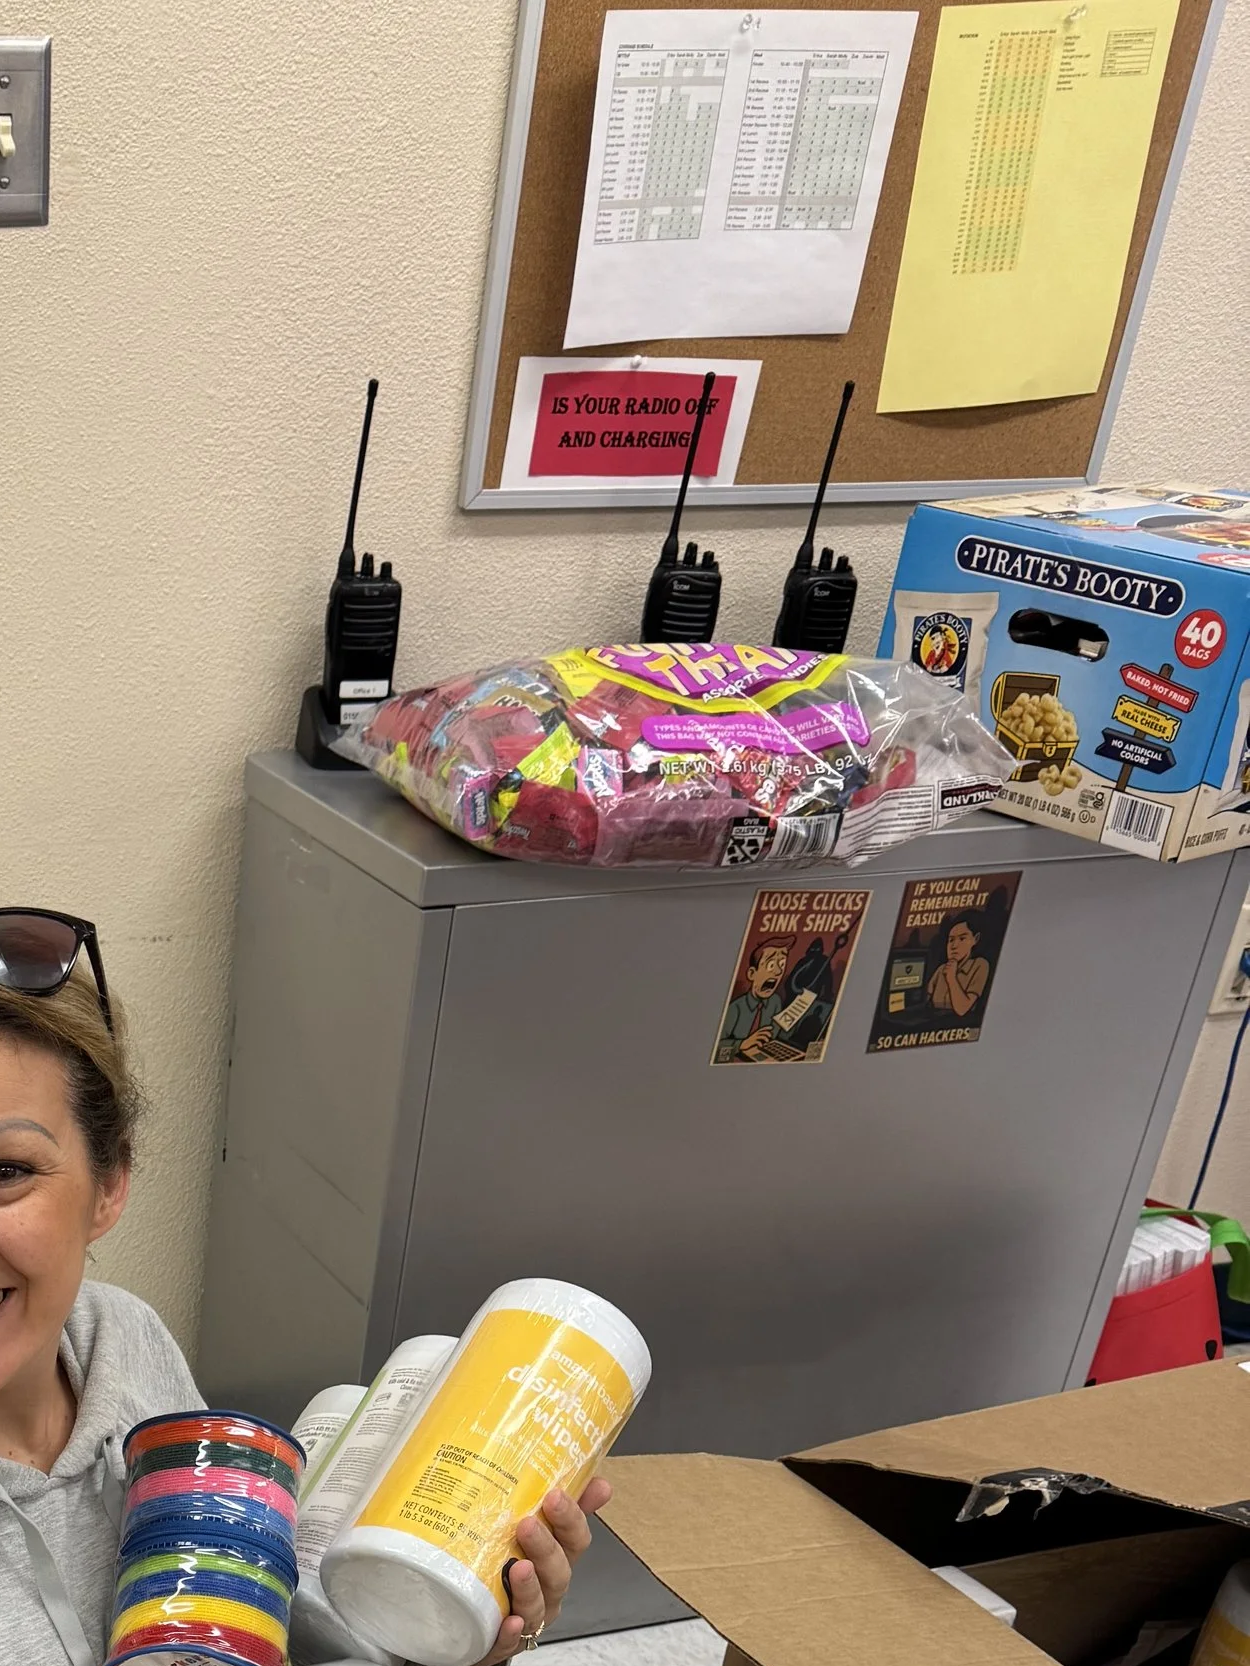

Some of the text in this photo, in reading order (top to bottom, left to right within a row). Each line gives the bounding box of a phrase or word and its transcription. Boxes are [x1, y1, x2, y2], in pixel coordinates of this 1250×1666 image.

[552, 394, 720, 416] IS YOUR RADIO OF
[558, 431, 596, 448] AND
[970, 543, 1168, 610] PIRATE'S BOOTY
[1182, 616, 1222, 649] 40
[1182, 646, 1211, 661] BAGS
[1126, 670, 1190, 706] BAKED, NOT FRIED
[796, 719, 820, 734] WILL
[1121, 709, 1168, 735] REAL CHEESE
[1111, 738, 1163, 762] NO ARTIFICIAL
[1119, 750, 1150, 766] COLORS
[659, 756, 854, 777] NET kg 92
[914, 878, 981, 896] IF YOU CAN
[760, 892, 864, 911] LOOSE CLICKS
[910, 892, 990, 912] REMEMBER IT
[761, 913, 853, 933] SINK SHIPS
[906, 912, 945, 927] EASILY
[876, 1027, 970, 1050] SO CAN HACKERS
[436, 1449, 468, 1465] CAUTION
[403, 1500, 458, 1528] NET CONTENTS:
[403, 1510, 449, 1536] lb 5.3 oz (605
